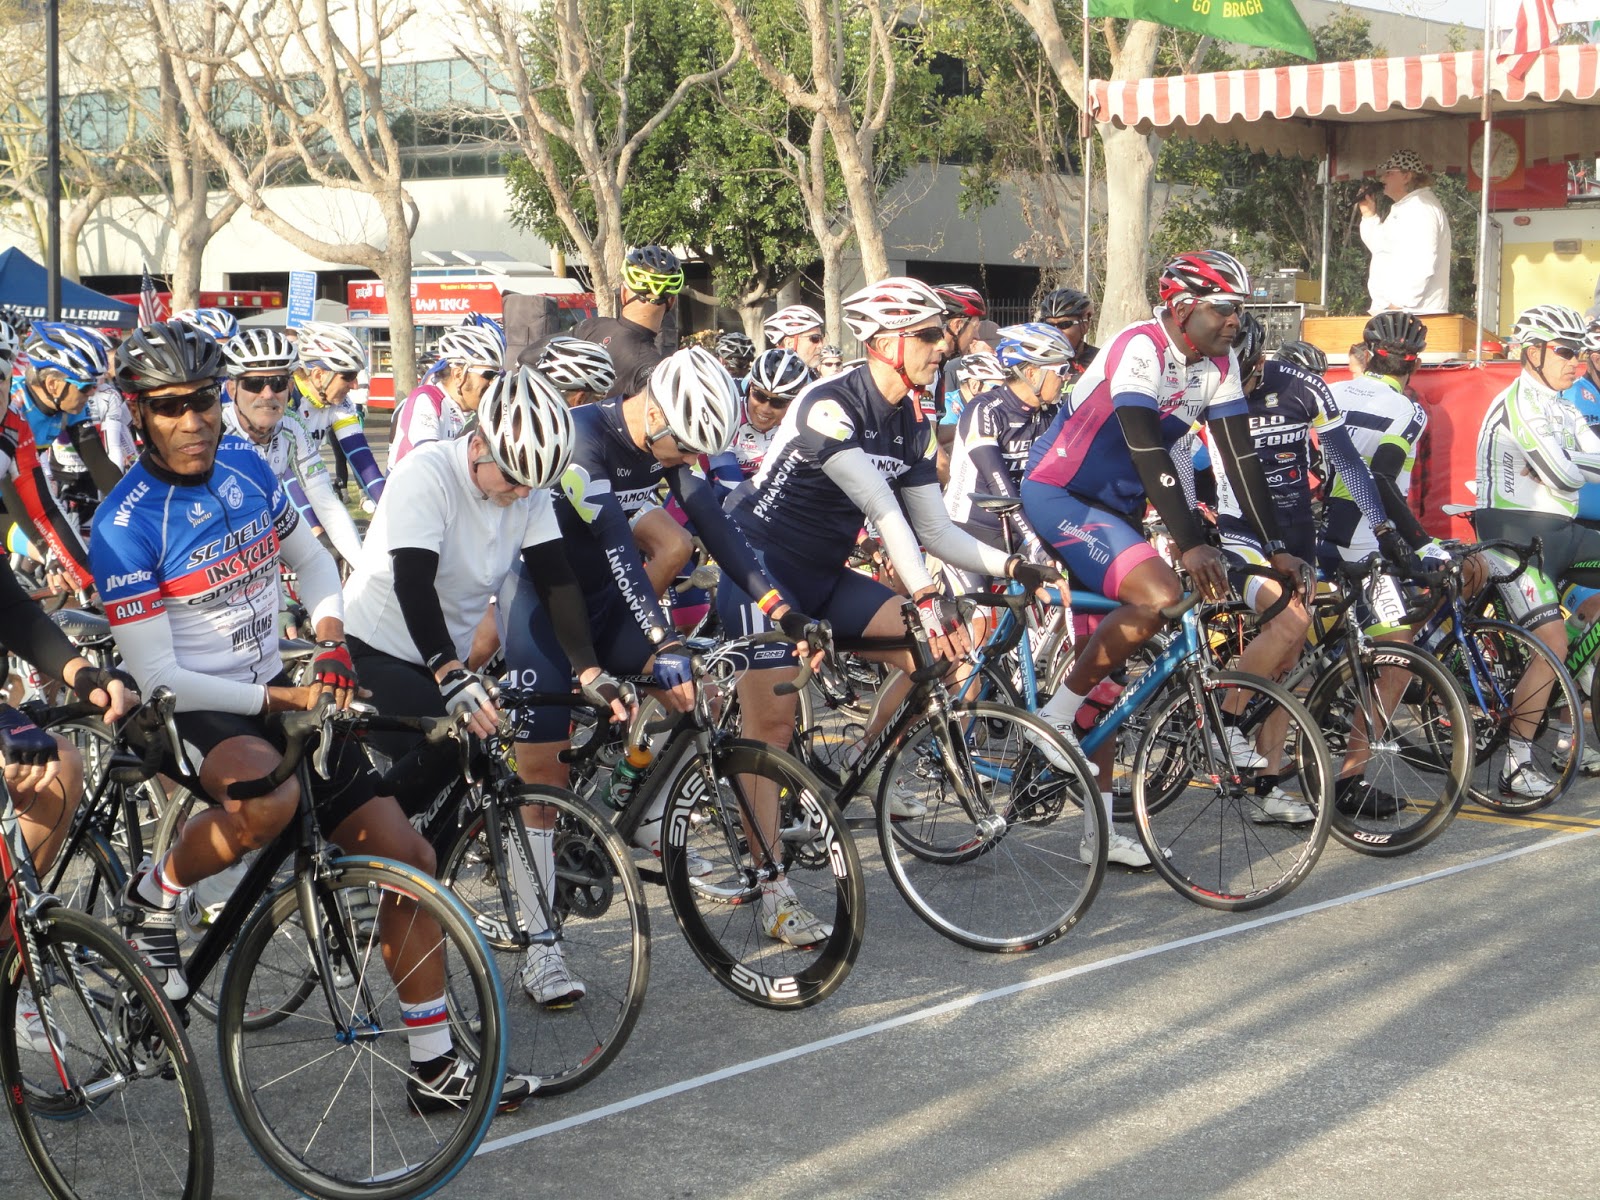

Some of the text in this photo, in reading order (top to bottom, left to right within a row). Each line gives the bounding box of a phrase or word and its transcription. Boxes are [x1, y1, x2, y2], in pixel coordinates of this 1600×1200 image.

[1192, 0, 1263, 18] GO BRAGH
[60, 308, 120, 321] LLEGRO
[439, 299, 470, 311] TRUCK
[1248, 415, 1285, 429] ELO
[1254, 429, 1307, 449] EGRO
[753, 448, 804, 519] PARAMOUNT
[112, 480, 151, 528] INCYCLE
[1057, 519, 1099, 548] Lightning
[188, 539, 221, 570] SC
[205, 534, 275, 585] INCYCLE
[1088, 544, 1110, 566] VELO
[115, 602, 147, 620] A.W.
[1542, 607, 1558, 619] VELO
[231, 612, 273, 646] WILLIAMS
[1374, 654, 1411, 668] ZIPP
[1018, 640, 1031, 705] SIMONETTI
[1099, 664, 1157, 728] SIMONETTI
[857, 698, 911, 776] KESTREL
[1353, 831, 1392, 845] ZIPP
